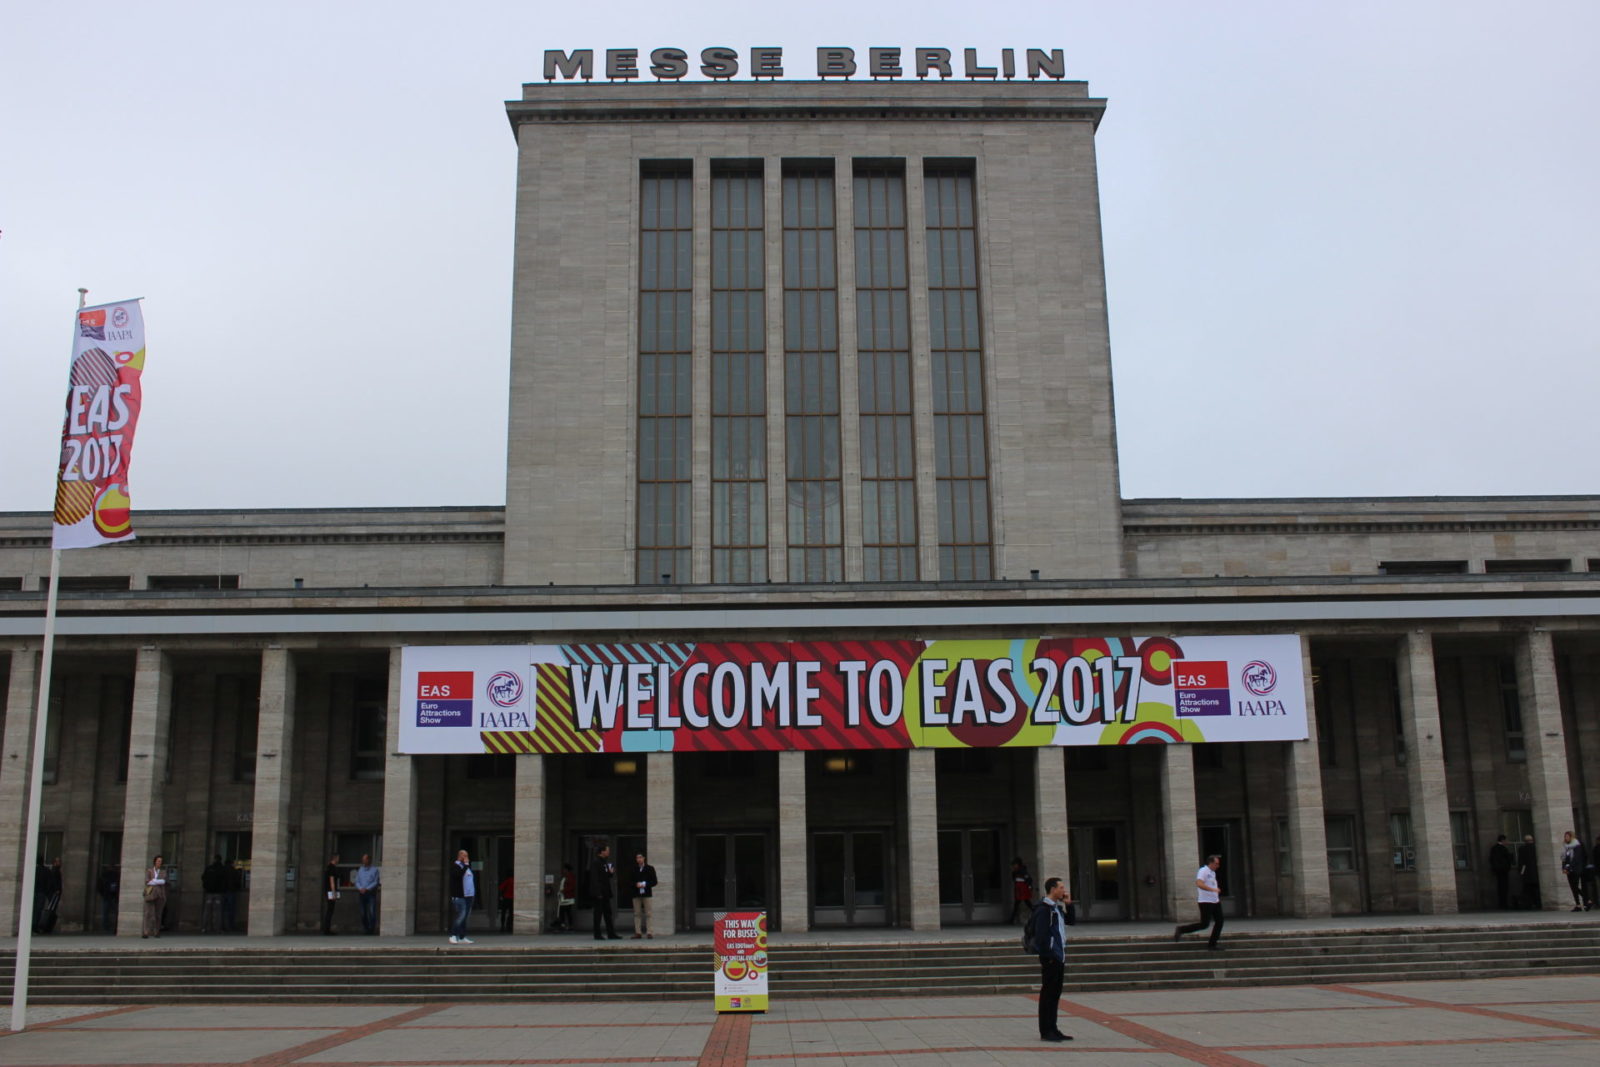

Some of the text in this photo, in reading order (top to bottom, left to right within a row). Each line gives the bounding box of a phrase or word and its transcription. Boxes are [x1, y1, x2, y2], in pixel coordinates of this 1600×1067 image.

[543, 47, 1066, 80] MESSE BERLIN
[69, 384, 131, 435] EAS
[62, 435, 124, 481] 2017
[1177, 675, 1207, 687] EAS
[420, 685, 451, 697] EAS
[569, 656, 1143, 730] WELCOME TO EAS 2017
[420, 702, 438, 710] Euro
[420, 709, 461, 717] Attractions
[1238, 699, 1287, 717] IAAPA
[480, 711, 531, 728] IAAPA
[725, 920, 755, 928] THIS WAY
[723, 930, 757, 938] FOR BUSES
